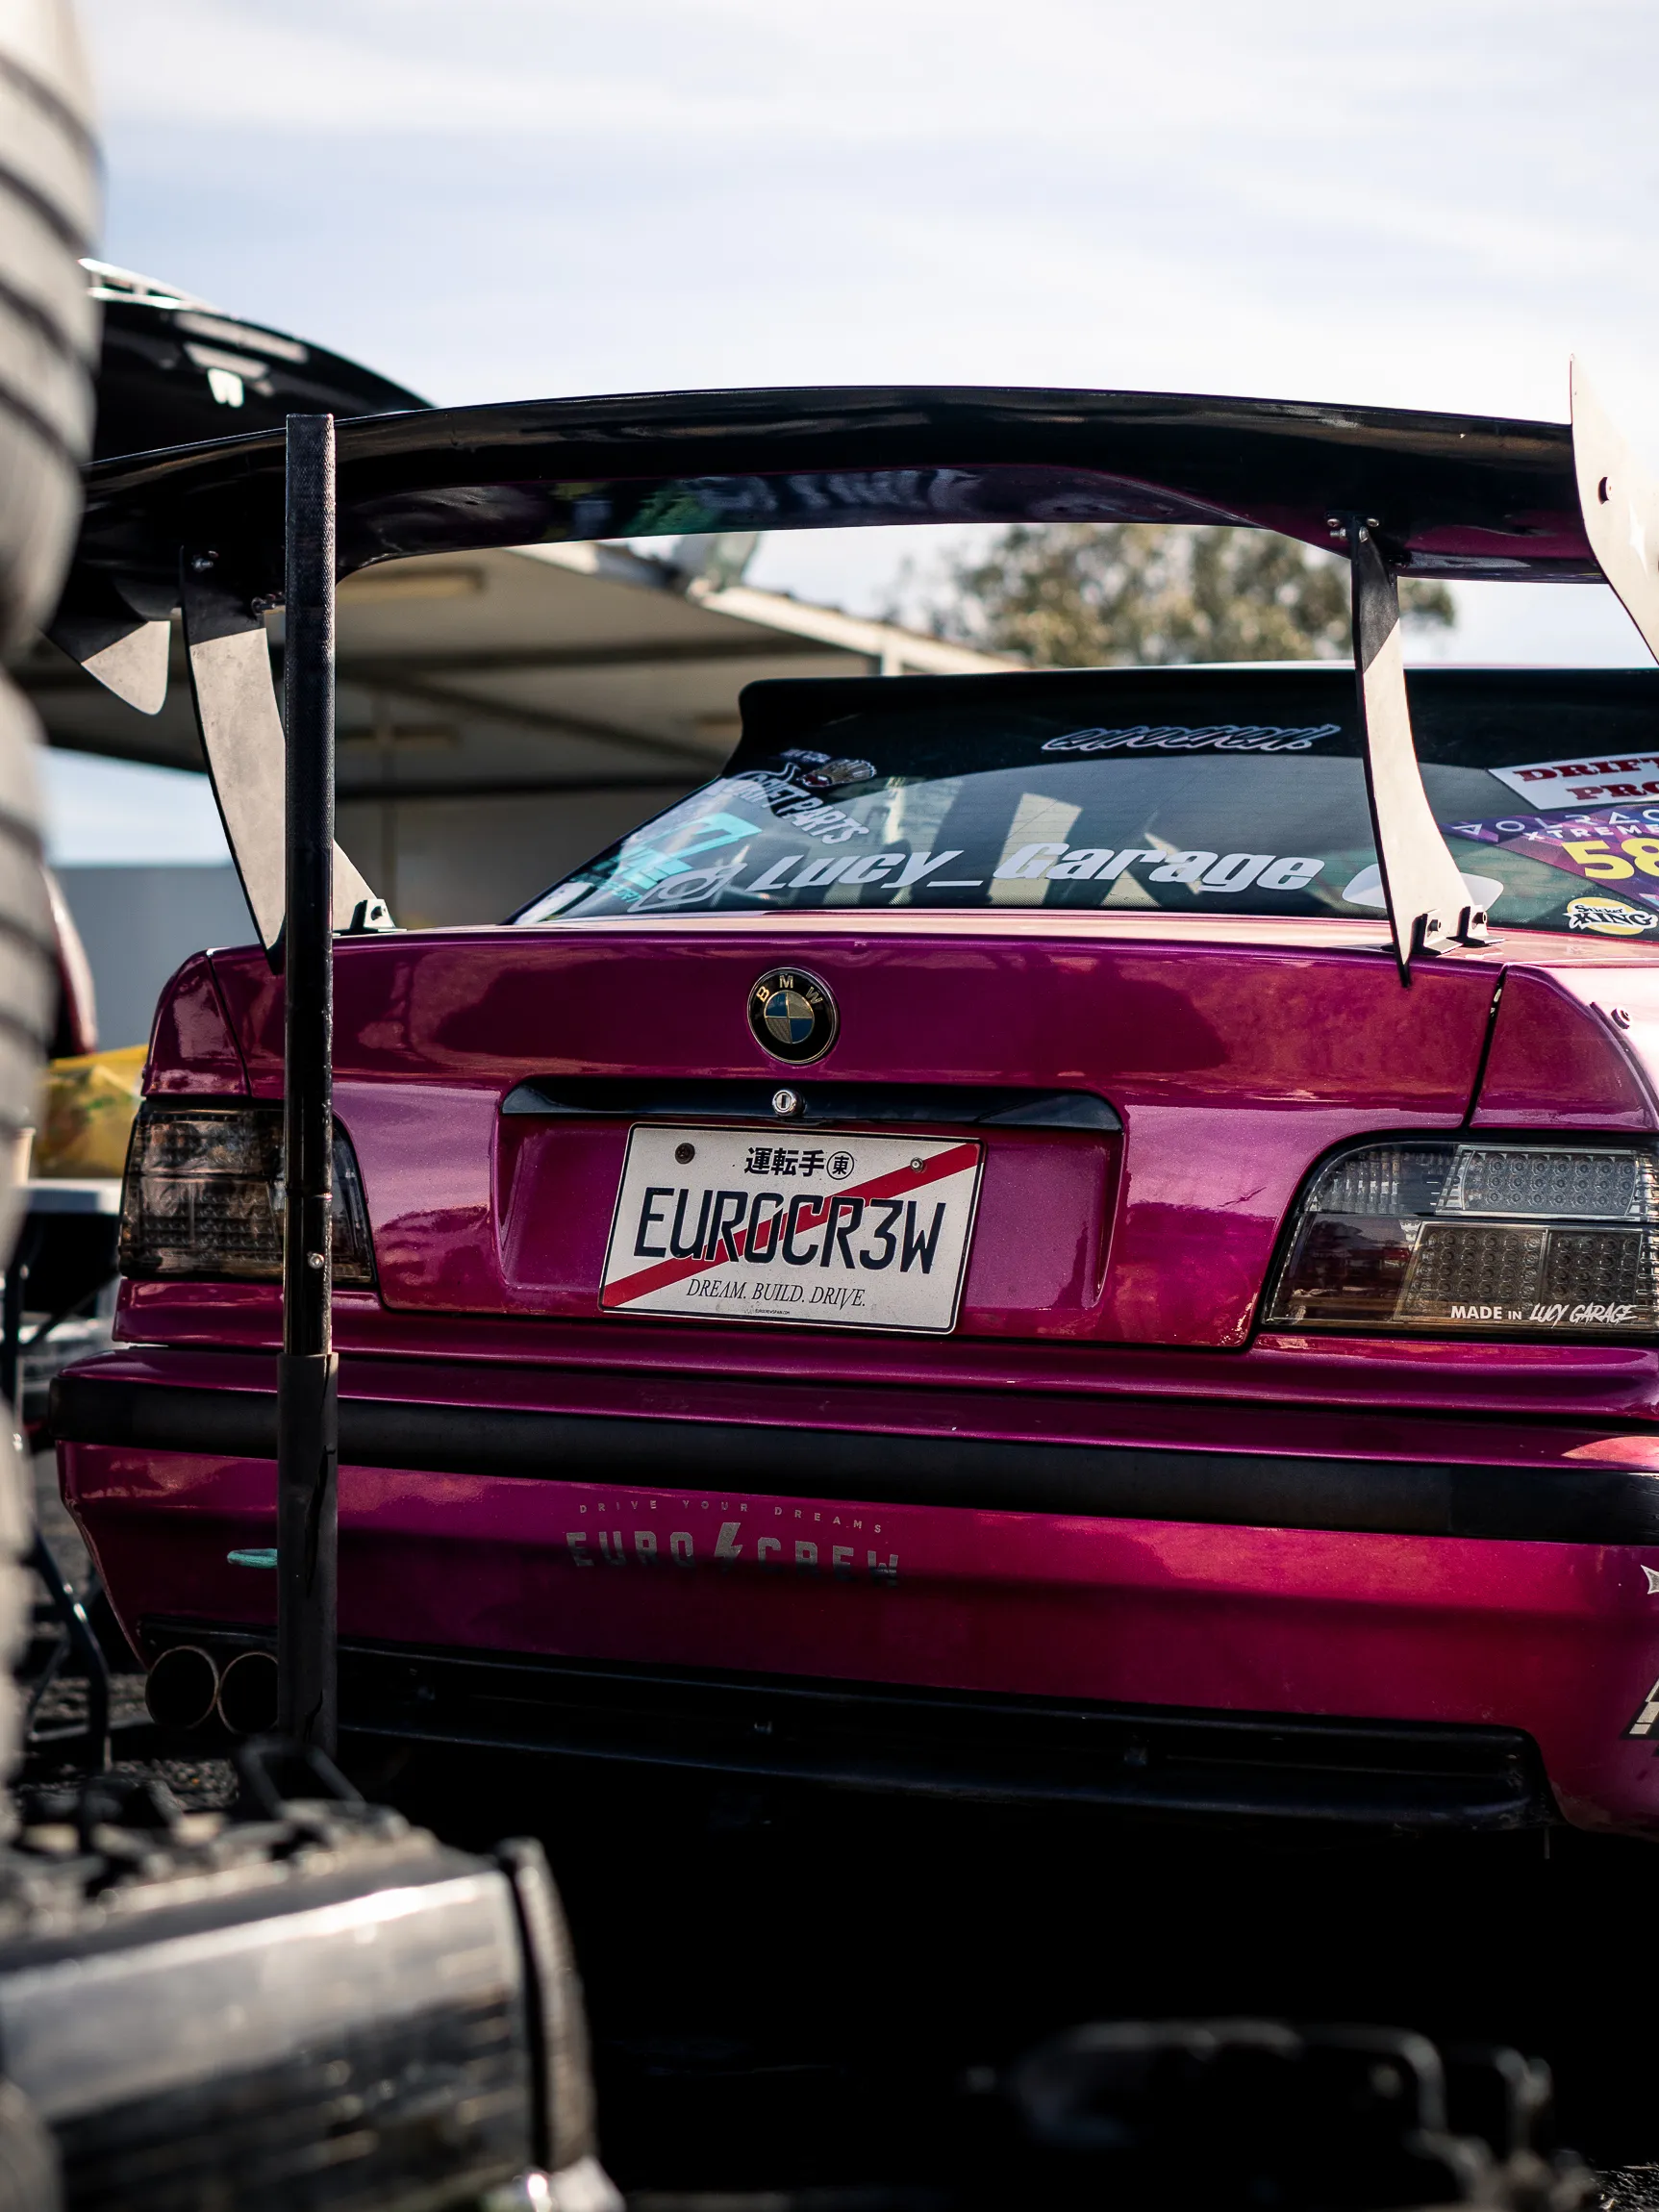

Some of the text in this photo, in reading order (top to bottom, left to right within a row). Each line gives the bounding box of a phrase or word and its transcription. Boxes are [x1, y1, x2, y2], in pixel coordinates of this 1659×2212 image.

[776, 796, 869, 844] PARTS
[993, 842, 1326, 893] Garage
[1572, 913, 1653, 926] KING
[756, 974, 823, 1005] BMW
[633, 1187, 946, 1274] EUROCR3W
[686, 1278, 867, 1311] DREAM. BUILD. DRIVE.
[1450, 1301, 1638, 1329] MADE IN LUCY GARAGE
[579, 1499, 883, 1534] DRIVE YOUR DREAMS
[566, 1530, 899, 1587] EURO CREW
